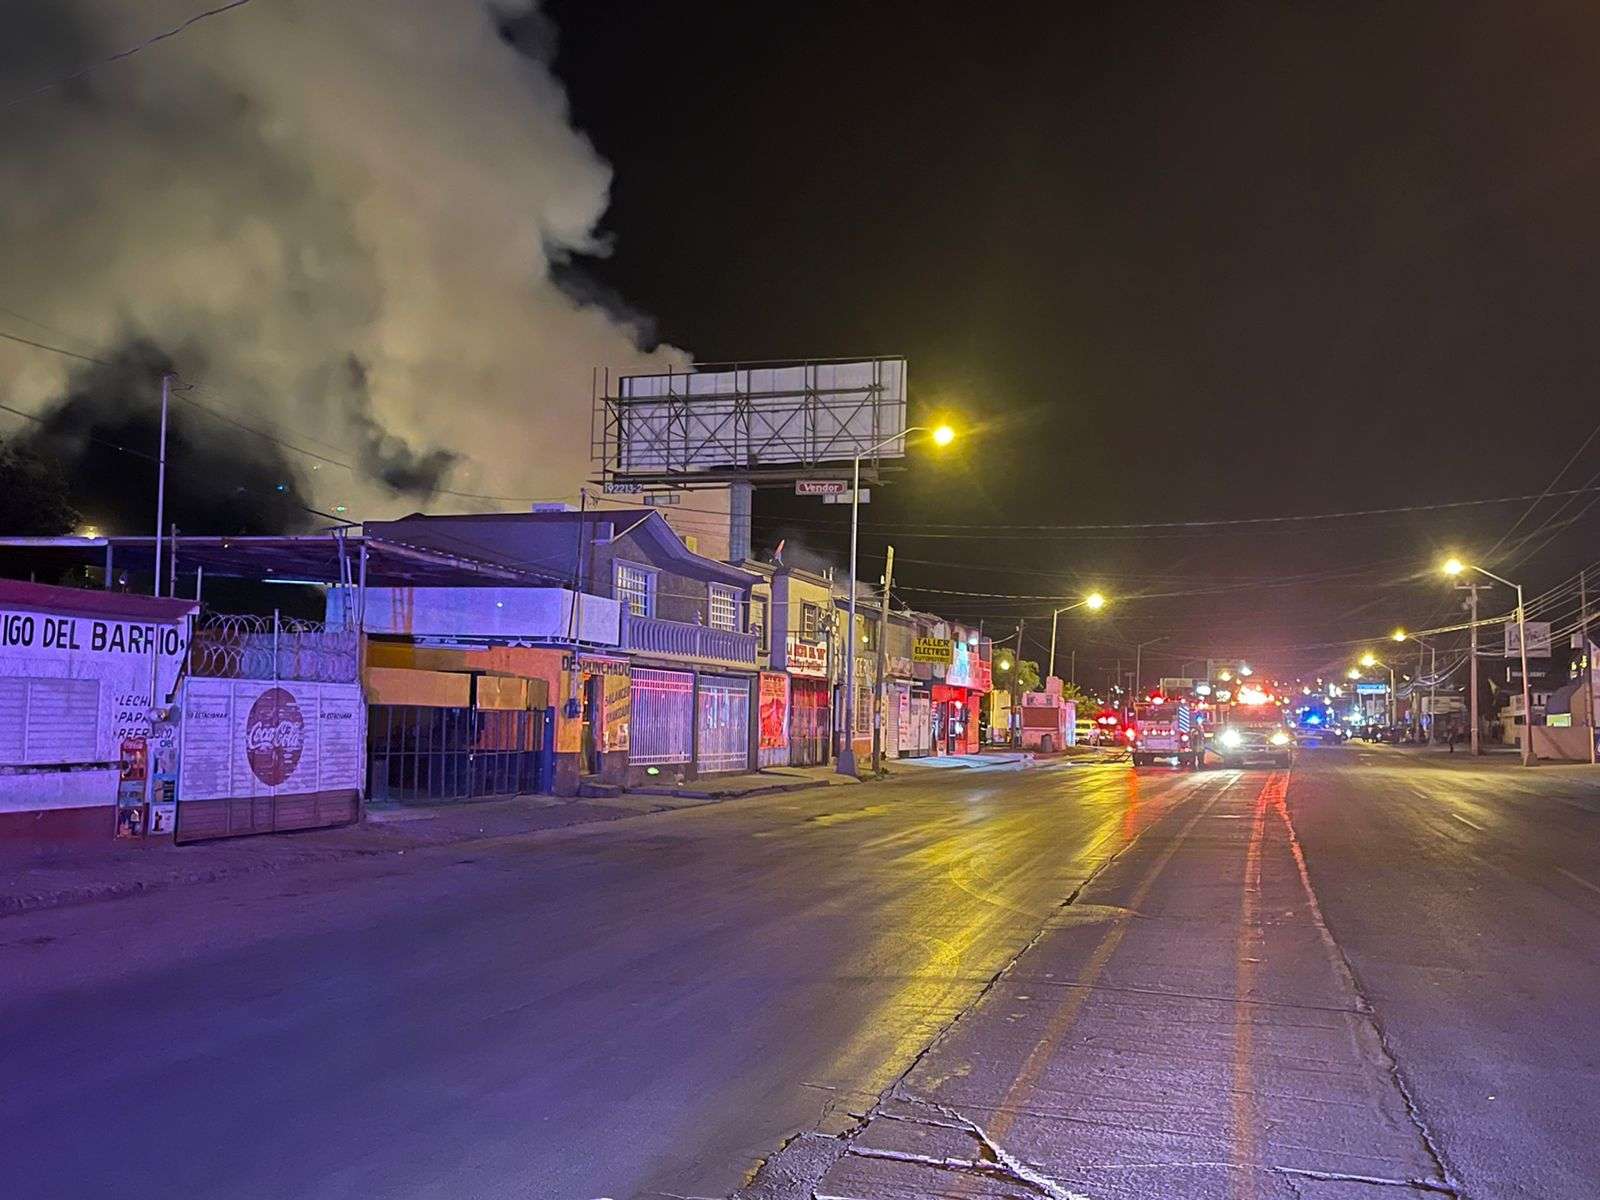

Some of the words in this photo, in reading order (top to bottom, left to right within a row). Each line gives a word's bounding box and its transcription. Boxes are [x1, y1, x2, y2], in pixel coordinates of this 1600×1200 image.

[804, 483, 839, 493] Vendor
[0, 614, 35, 646] IGO
[43, 617, 81, 650] DEL
[916, 638, 950, 648] TALLER
